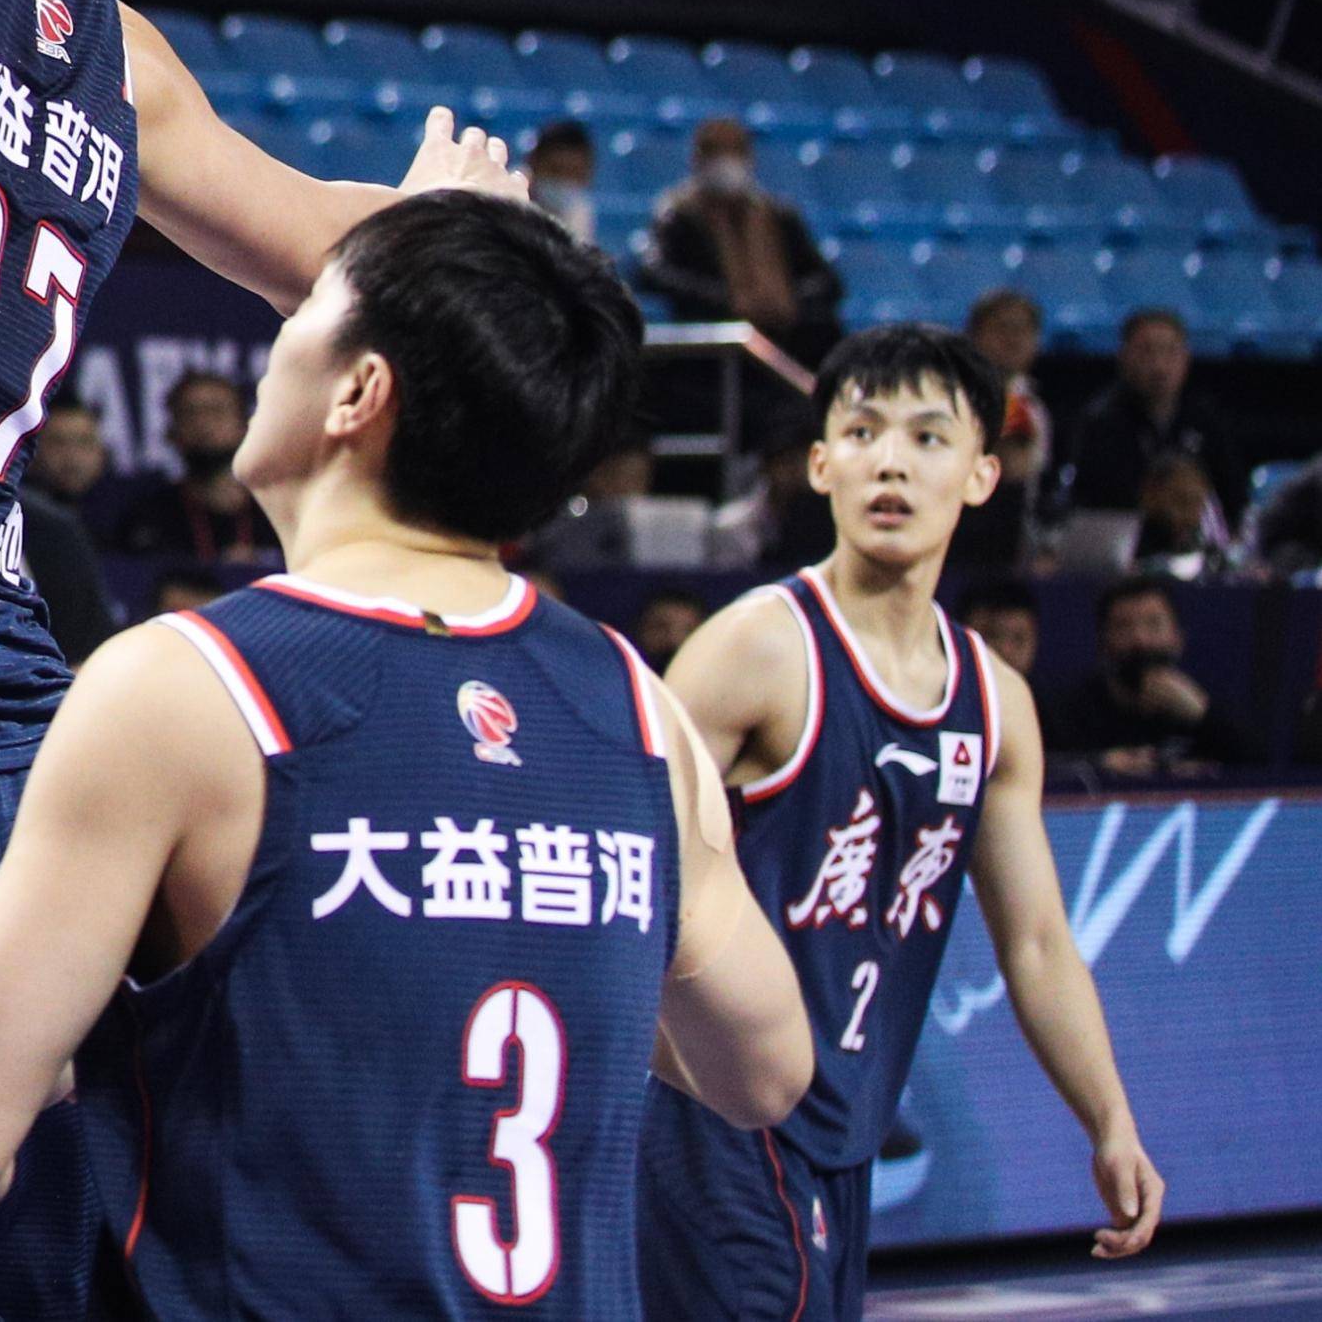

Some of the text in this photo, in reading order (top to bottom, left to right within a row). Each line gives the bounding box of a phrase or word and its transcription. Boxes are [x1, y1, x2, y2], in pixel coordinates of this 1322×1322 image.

[309, 816, 655, 935] 大益普洱
[838, 959, 881, 1053] 2
[450, 980, 568, 1306] 3
